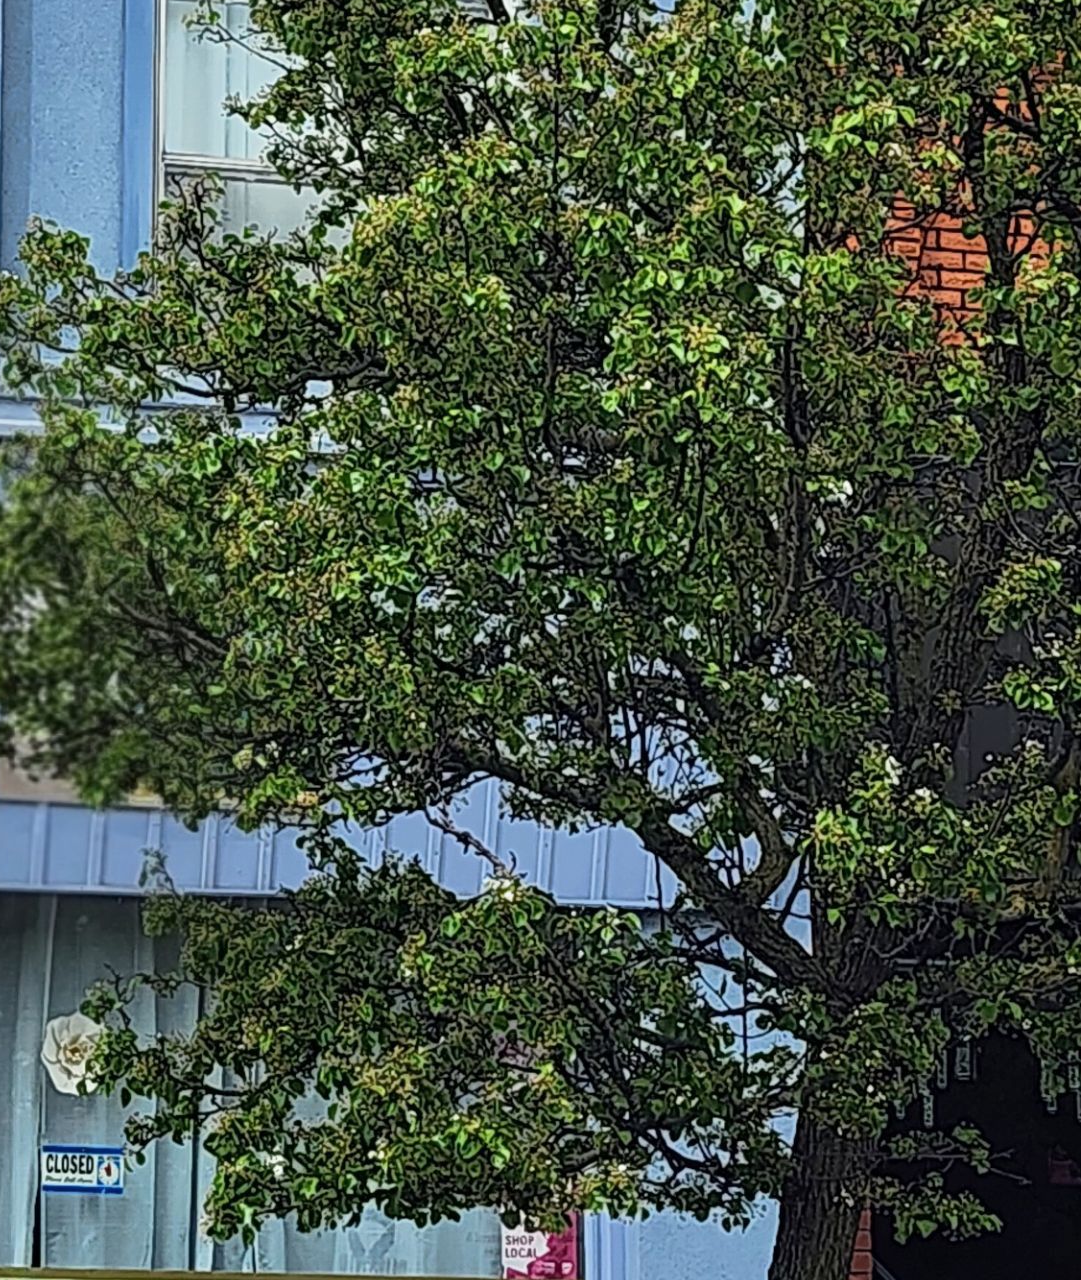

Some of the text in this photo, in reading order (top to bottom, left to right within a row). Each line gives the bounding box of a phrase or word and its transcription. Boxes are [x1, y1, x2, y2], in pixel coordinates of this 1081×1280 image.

[46, 1153, 95, 1175] CLOSED
[505, 1235, 535, 1246] SHOP
[505, 1248, 537, 1258] LOCAL
